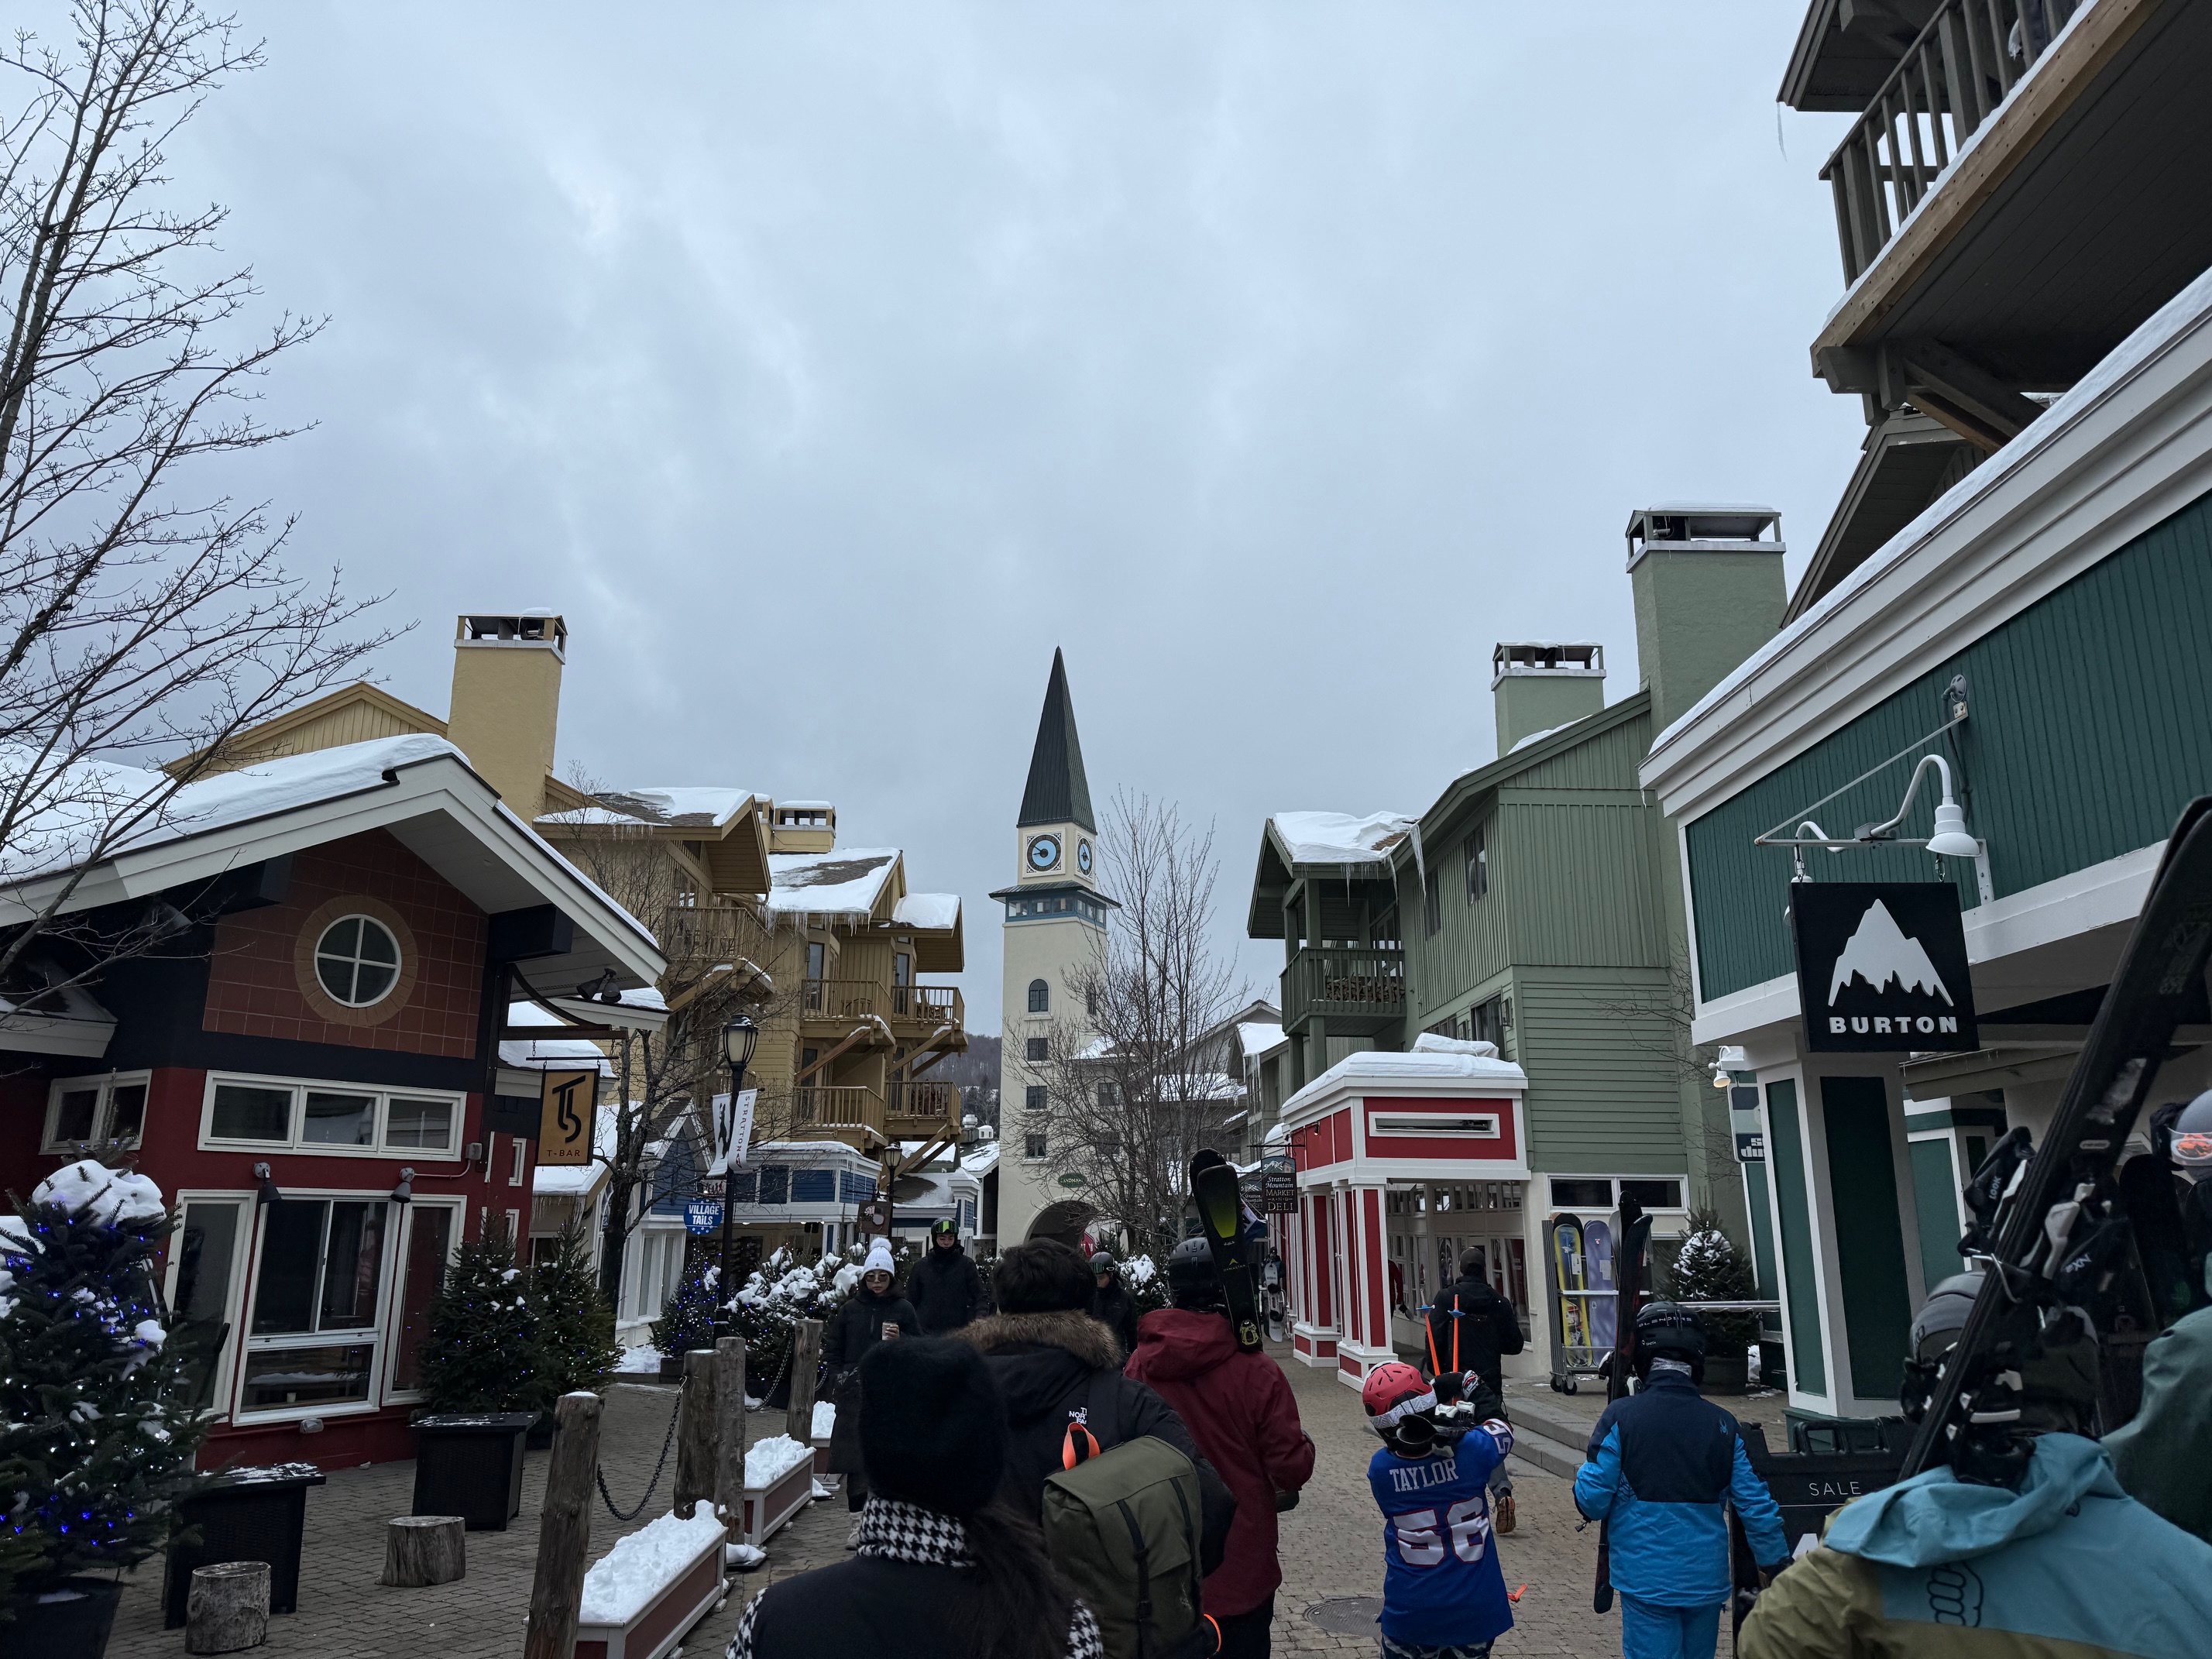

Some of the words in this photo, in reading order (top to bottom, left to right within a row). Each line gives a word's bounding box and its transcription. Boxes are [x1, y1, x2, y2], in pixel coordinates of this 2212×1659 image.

[1829, 1016, 1958, 1034] BURTON
[736, 1095, 750, 1152] STRATTON
[1740, 1146, 1764, 1158] du
[1988, 1176, 2002, 1200] LOOK
[689, 1204, 720, 1215] VILLAGE
[1267, 1202, 1294, 1211] DELI
[1069, 1410, 1087, 1420] NOR
[1389, 1458, 1459, 1492] TAYLOR
[1808, 1481, 1862, 1496] SALE
[1393, 1496, 1490, 1568] 56
